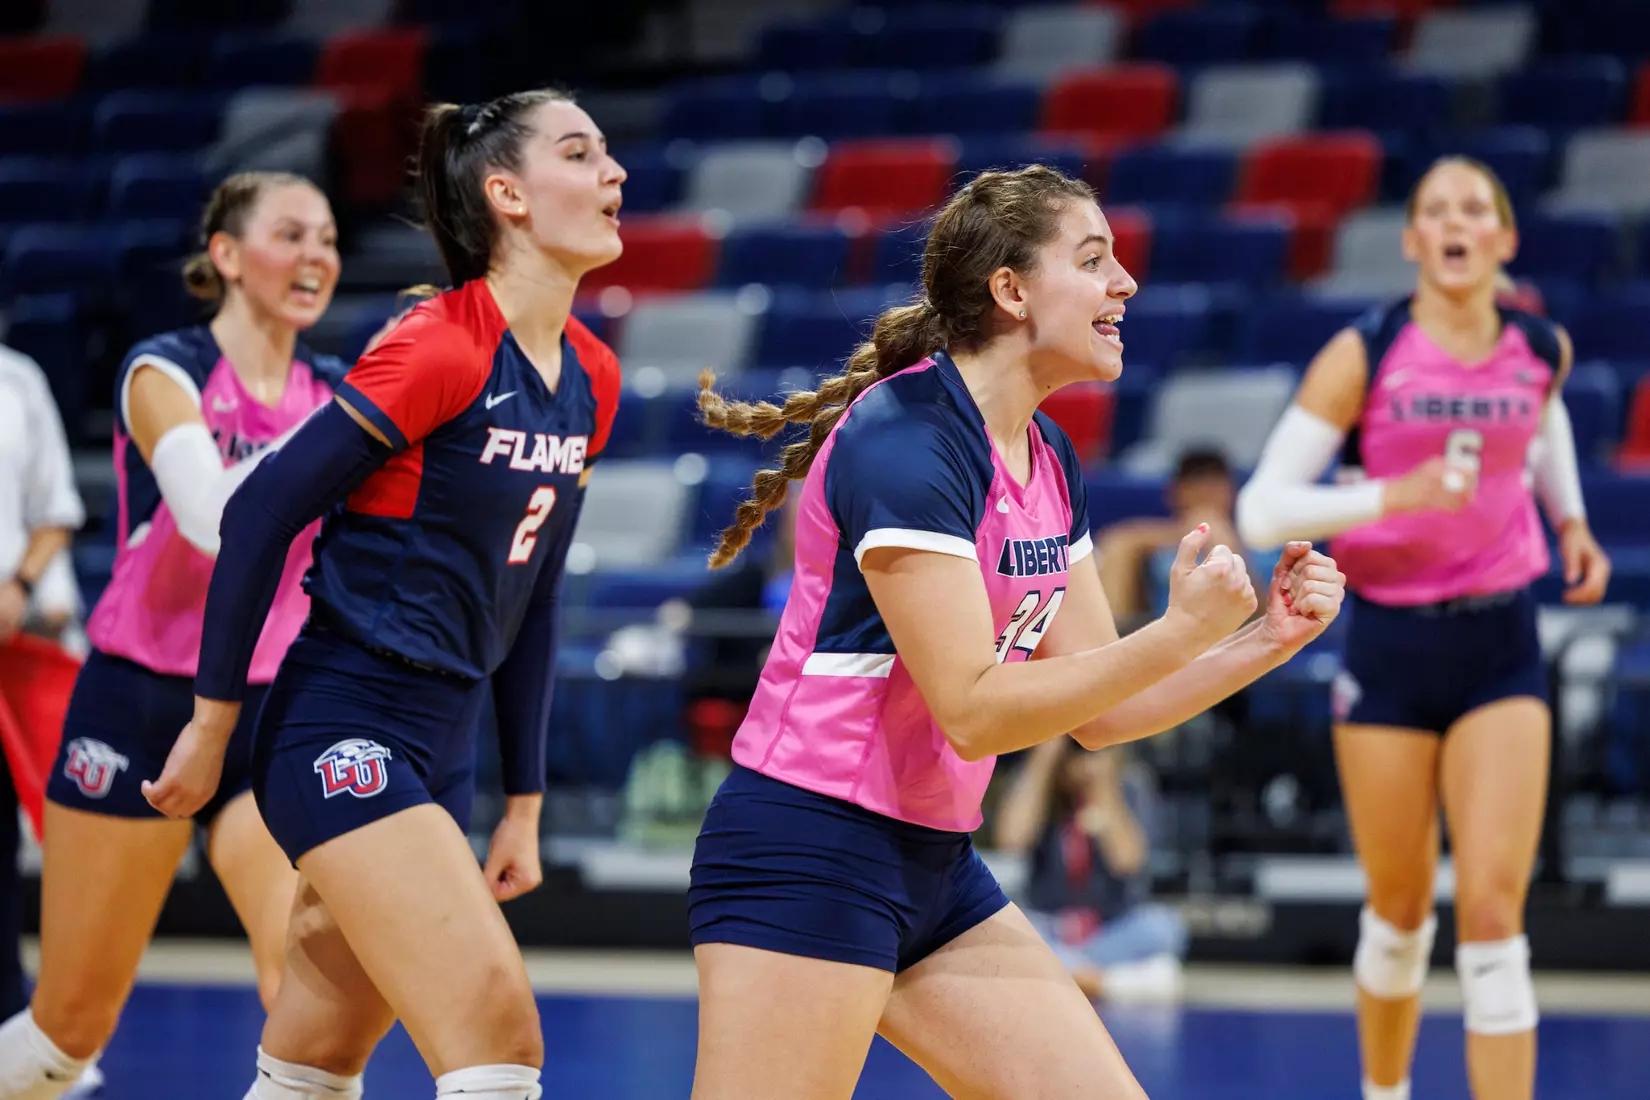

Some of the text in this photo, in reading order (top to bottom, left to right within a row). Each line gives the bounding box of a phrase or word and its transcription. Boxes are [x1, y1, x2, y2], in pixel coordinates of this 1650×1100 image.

[479, 427, 588, 475] FLAME
[507, 485, 557, 565] 2
[996, 534, 1069, 578] LIBERT
[995, 587, 1066, 664] 34
[313, 755, 388, 799] LU
